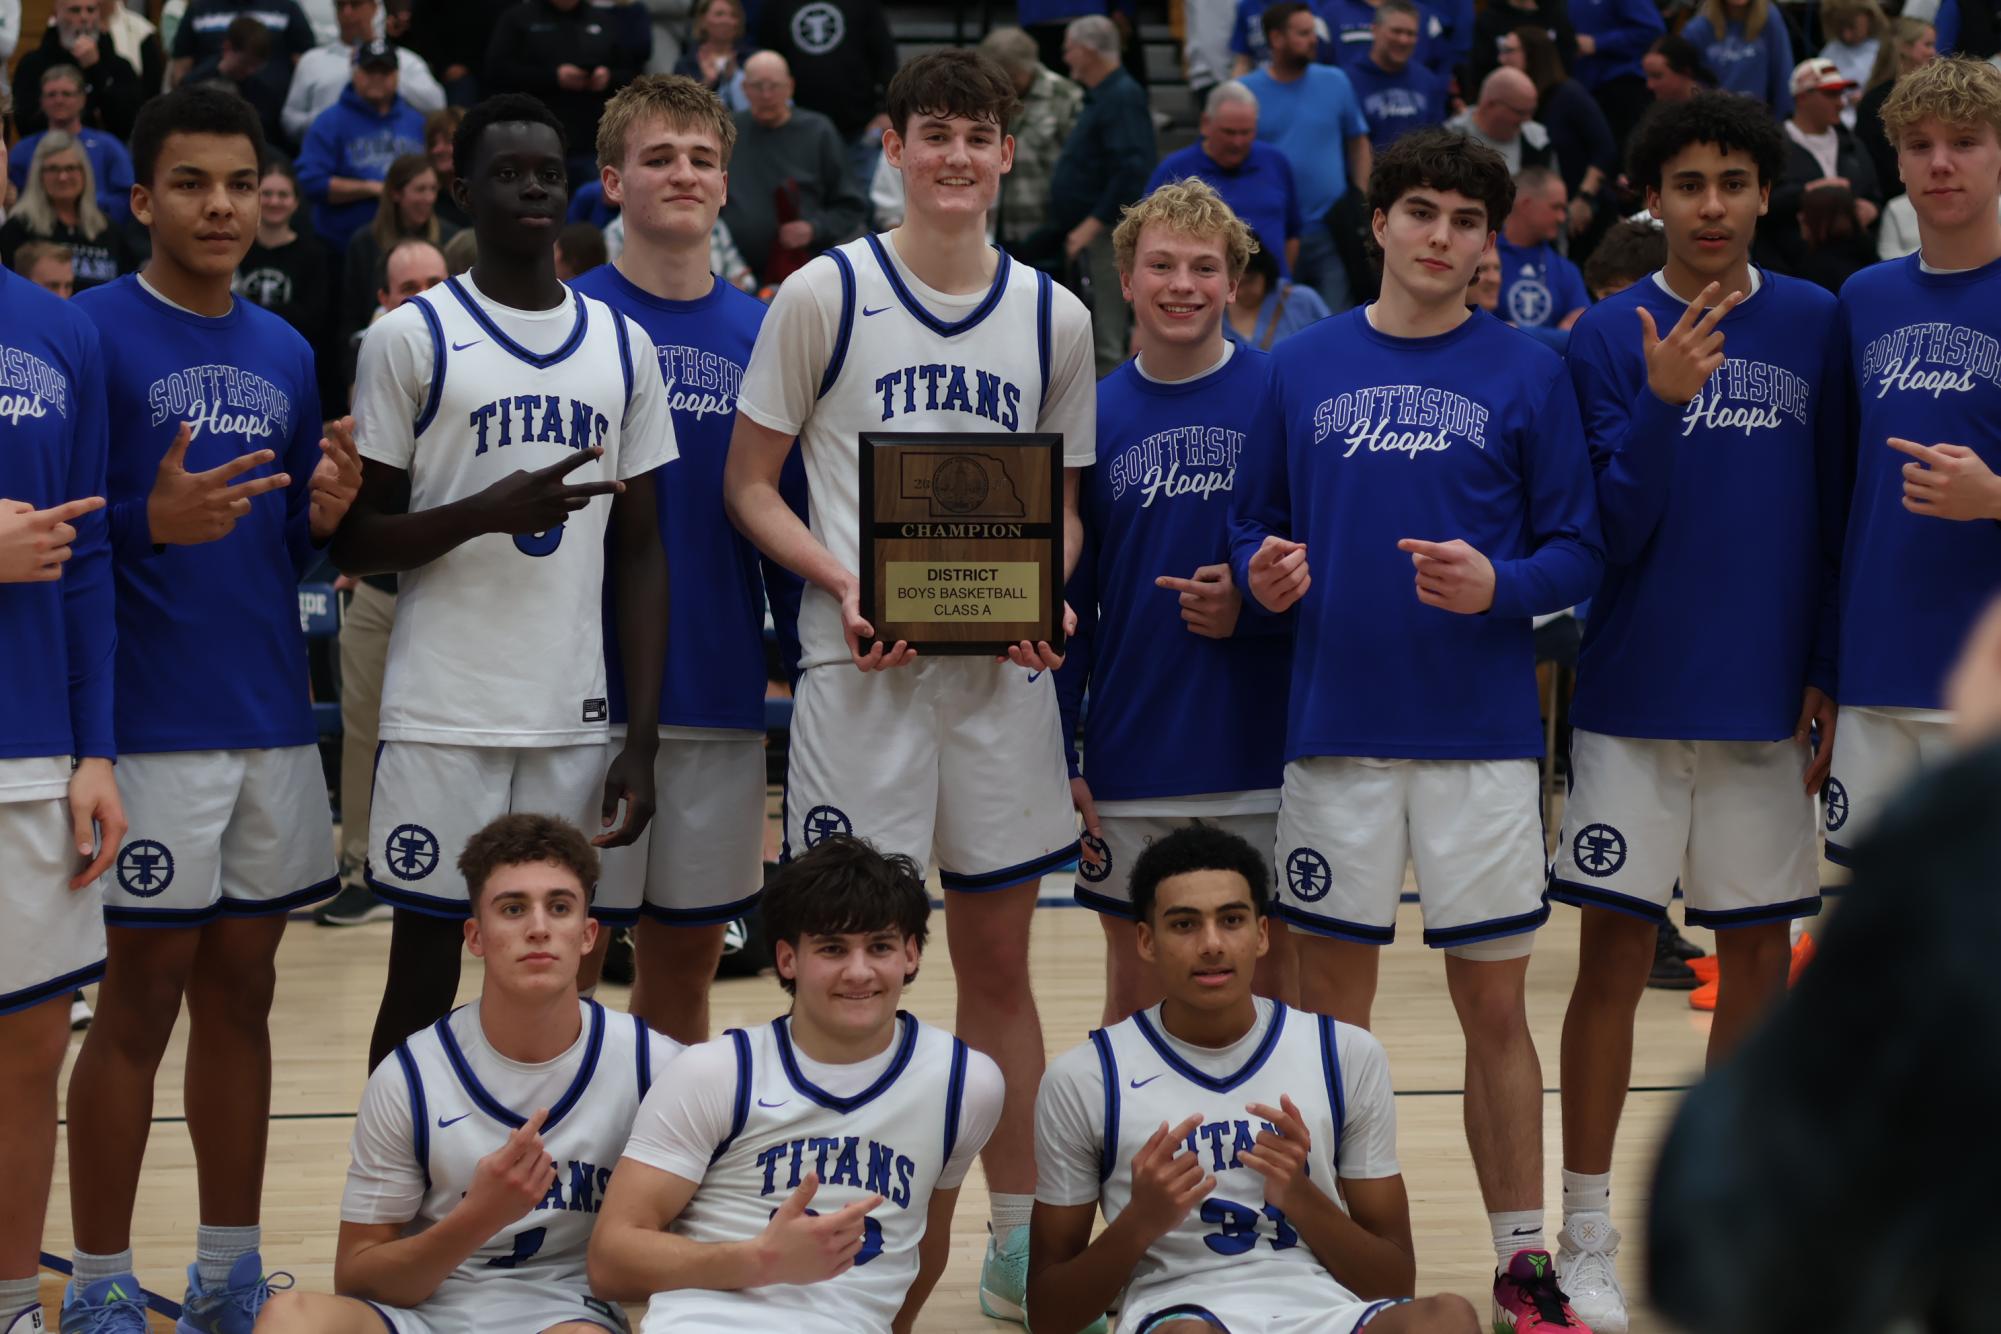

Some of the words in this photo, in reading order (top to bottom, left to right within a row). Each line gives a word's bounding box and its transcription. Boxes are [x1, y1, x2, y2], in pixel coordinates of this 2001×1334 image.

[657, 344, 745, 400] THSID
[1701, 358, 1809, 424] THSIDE
[1877, 357, 1976, 398] Hoops
[0, 394, 47, 426] ops
[149, 364, 291, 439] SOUTHSIDE
[187, 399, 272, 443] Hoops
[876, 364, 1020, 432] TITANS
[1313, 384, 1489, 449] SOUTHSIDE
[1682, 393, 1782, 436] Hoops
[470, 394, 608, 457] TITANS
[1342, 417, 1452, 460] Hoops
[1110, 425, 1246, 500] SOUTHSI
[1141, 461, 1235, 508] Hoops
[901, 524, 1022, 538] CHAMPION
[898, 587, 936, 599] BOYS
[940, 587, 1027, 599] BASKETBALL
[927, 569, 999, 581] DISTRICT
[934, 604, 978, 616] CLASS
[982, 604, 992, 616] A
[756, 1136, 915, 1209] TITANS
[1200, 1197, 1298, 1256] 31
